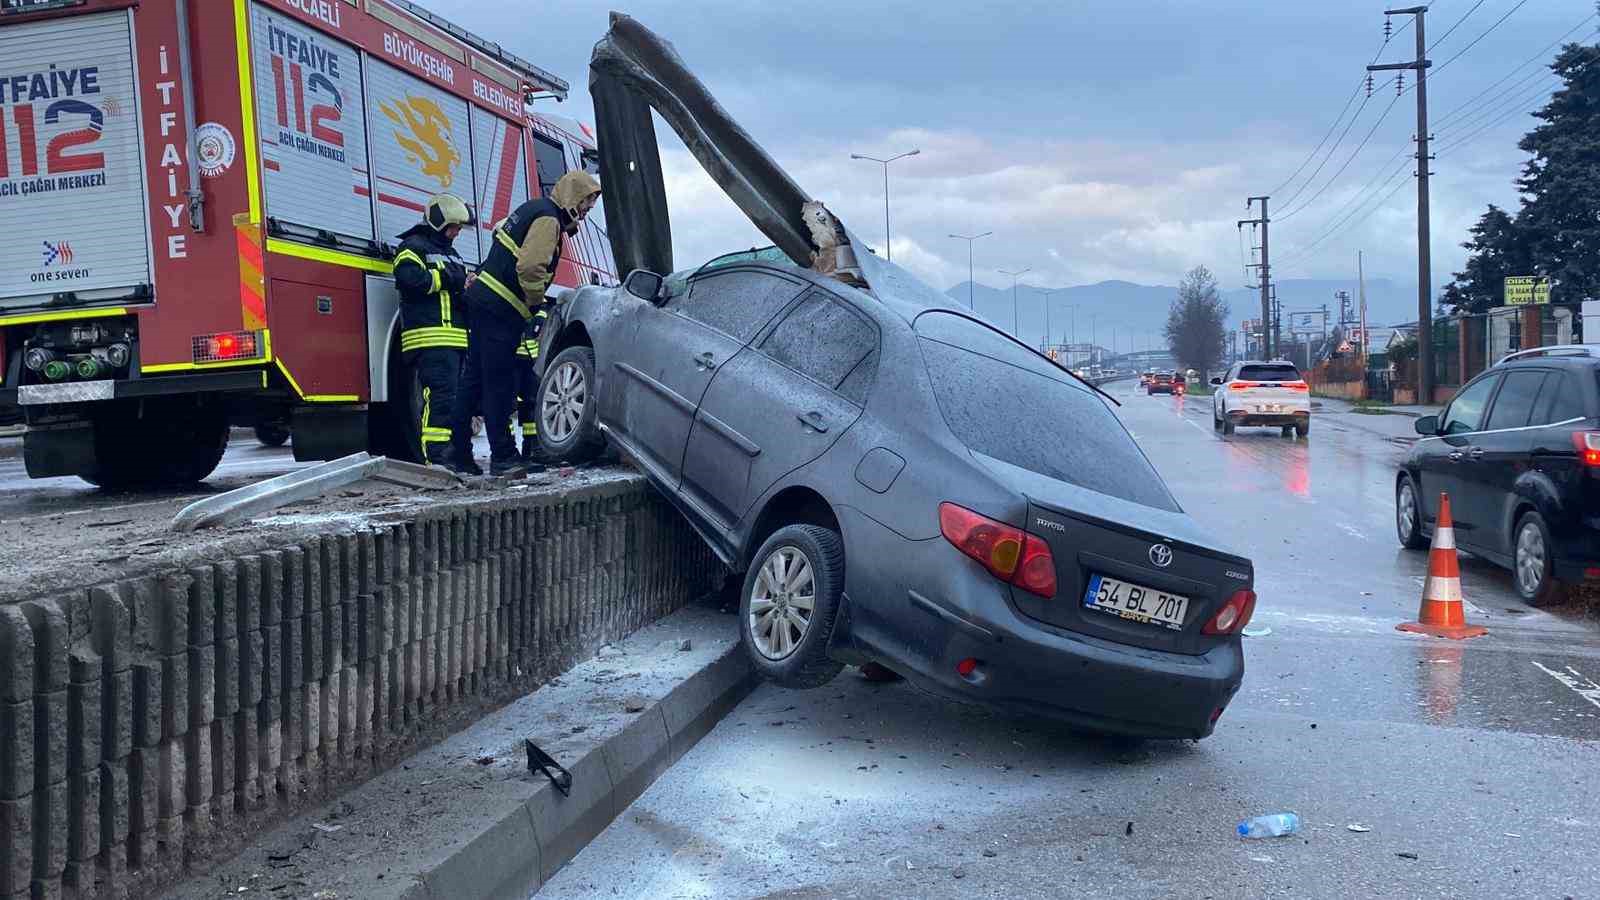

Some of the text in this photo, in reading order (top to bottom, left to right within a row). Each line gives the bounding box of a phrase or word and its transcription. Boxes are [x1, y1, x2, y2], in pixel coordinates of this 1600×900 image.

[267, 17, 340, 79] İTFAİYE
[286, 0, 522, 117] CAELİ BÜYÜKŞEHİR BELEDİYESİ
[0, 64, 100, 103] TFAİYE
[270, 54, 344, 147] 112
[156, 45, 187, 258] İTFAİYE
[279, 129, 294, 149] ACİL
[318, 143, 345, 163] MERKEZİ
[0, 169, 106, 197] CİL ÇAĞRI MERKEZİ
[30, 268, 89, 282] one seven
[1036, 518, 1065, 533] TOYOTA
[1097, 580, 1183, 620] 54 BL 701
